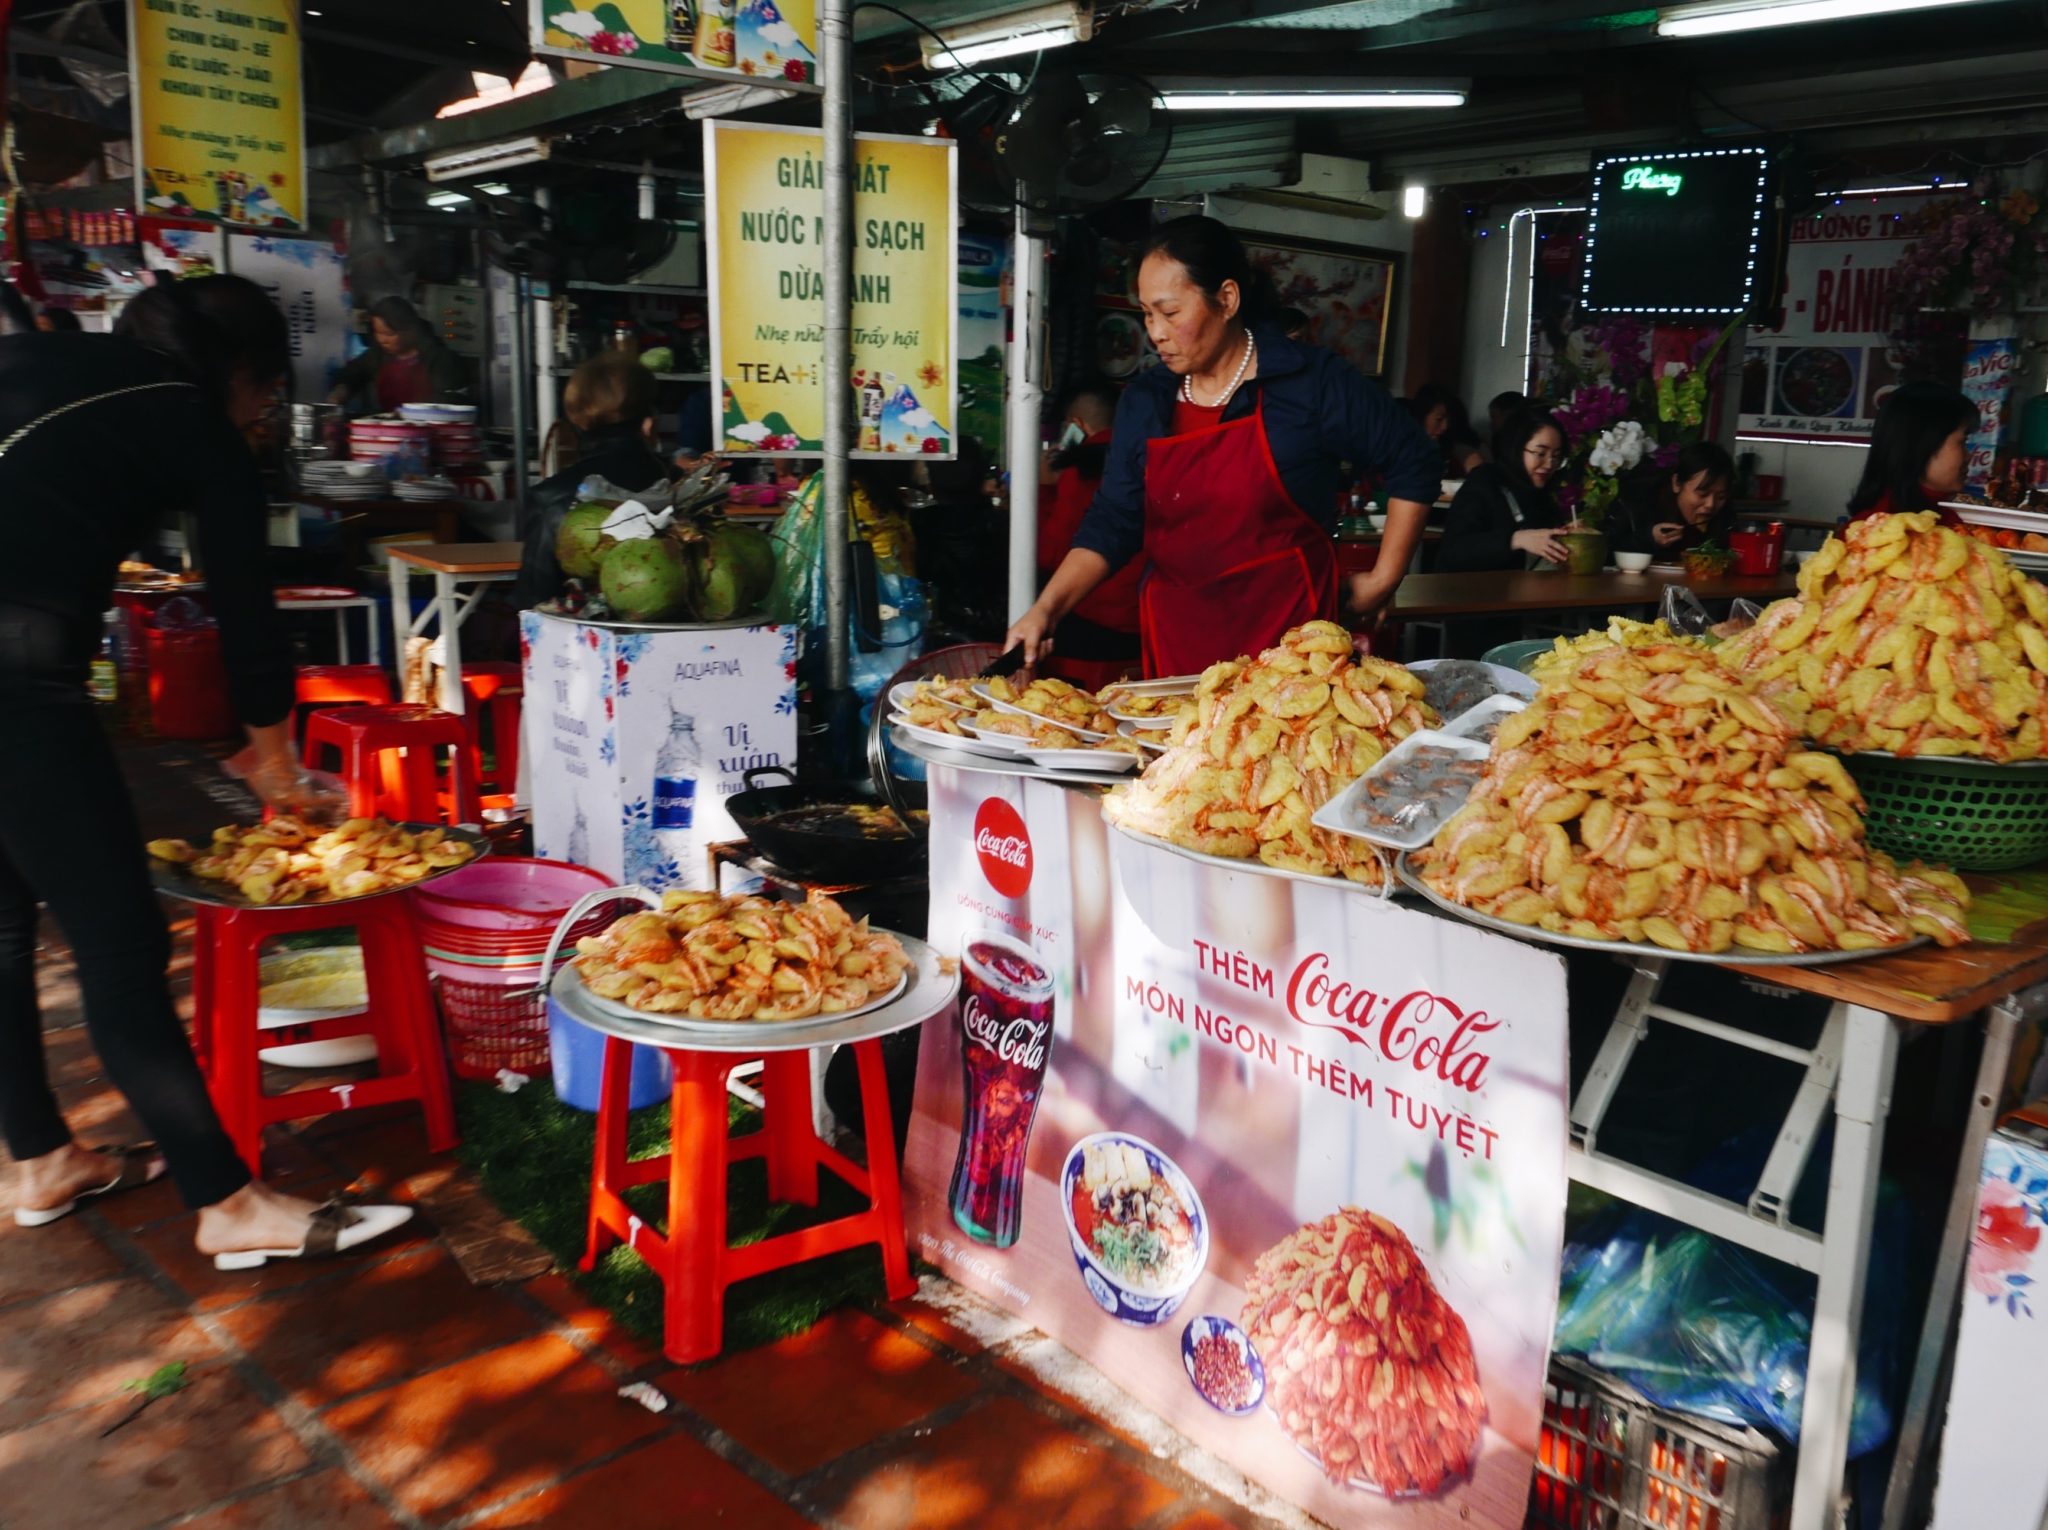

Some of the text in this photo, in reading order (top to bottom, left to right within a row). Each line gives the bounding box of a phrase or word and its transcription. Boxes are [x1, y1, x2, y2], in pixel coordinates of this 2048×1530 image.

[852, 156, 890, 193] HÁT
[741, 206, 805, 245] NƯỚC
[866, 218, 925, 256] SẠCH
[779, 264, 824, 301] DỪA
[755, 324, 790, 345] Nhẹ
[893, 328, 919, 346] hội
[674, 658, 744, 683] AQUAFINA
[723, 721, 751, 751] Vị
[716, 778, 765, 796] thun
[977, 827, 1028, 868] Coca-Cola
[963, 994, 1049, 1071] Coca-Cola
[1193, 938, 1502, 1093] THÊM Coca-Cola
[1127, 974, 1499, 1161] MÓN NGON THÊM TUYỆT
